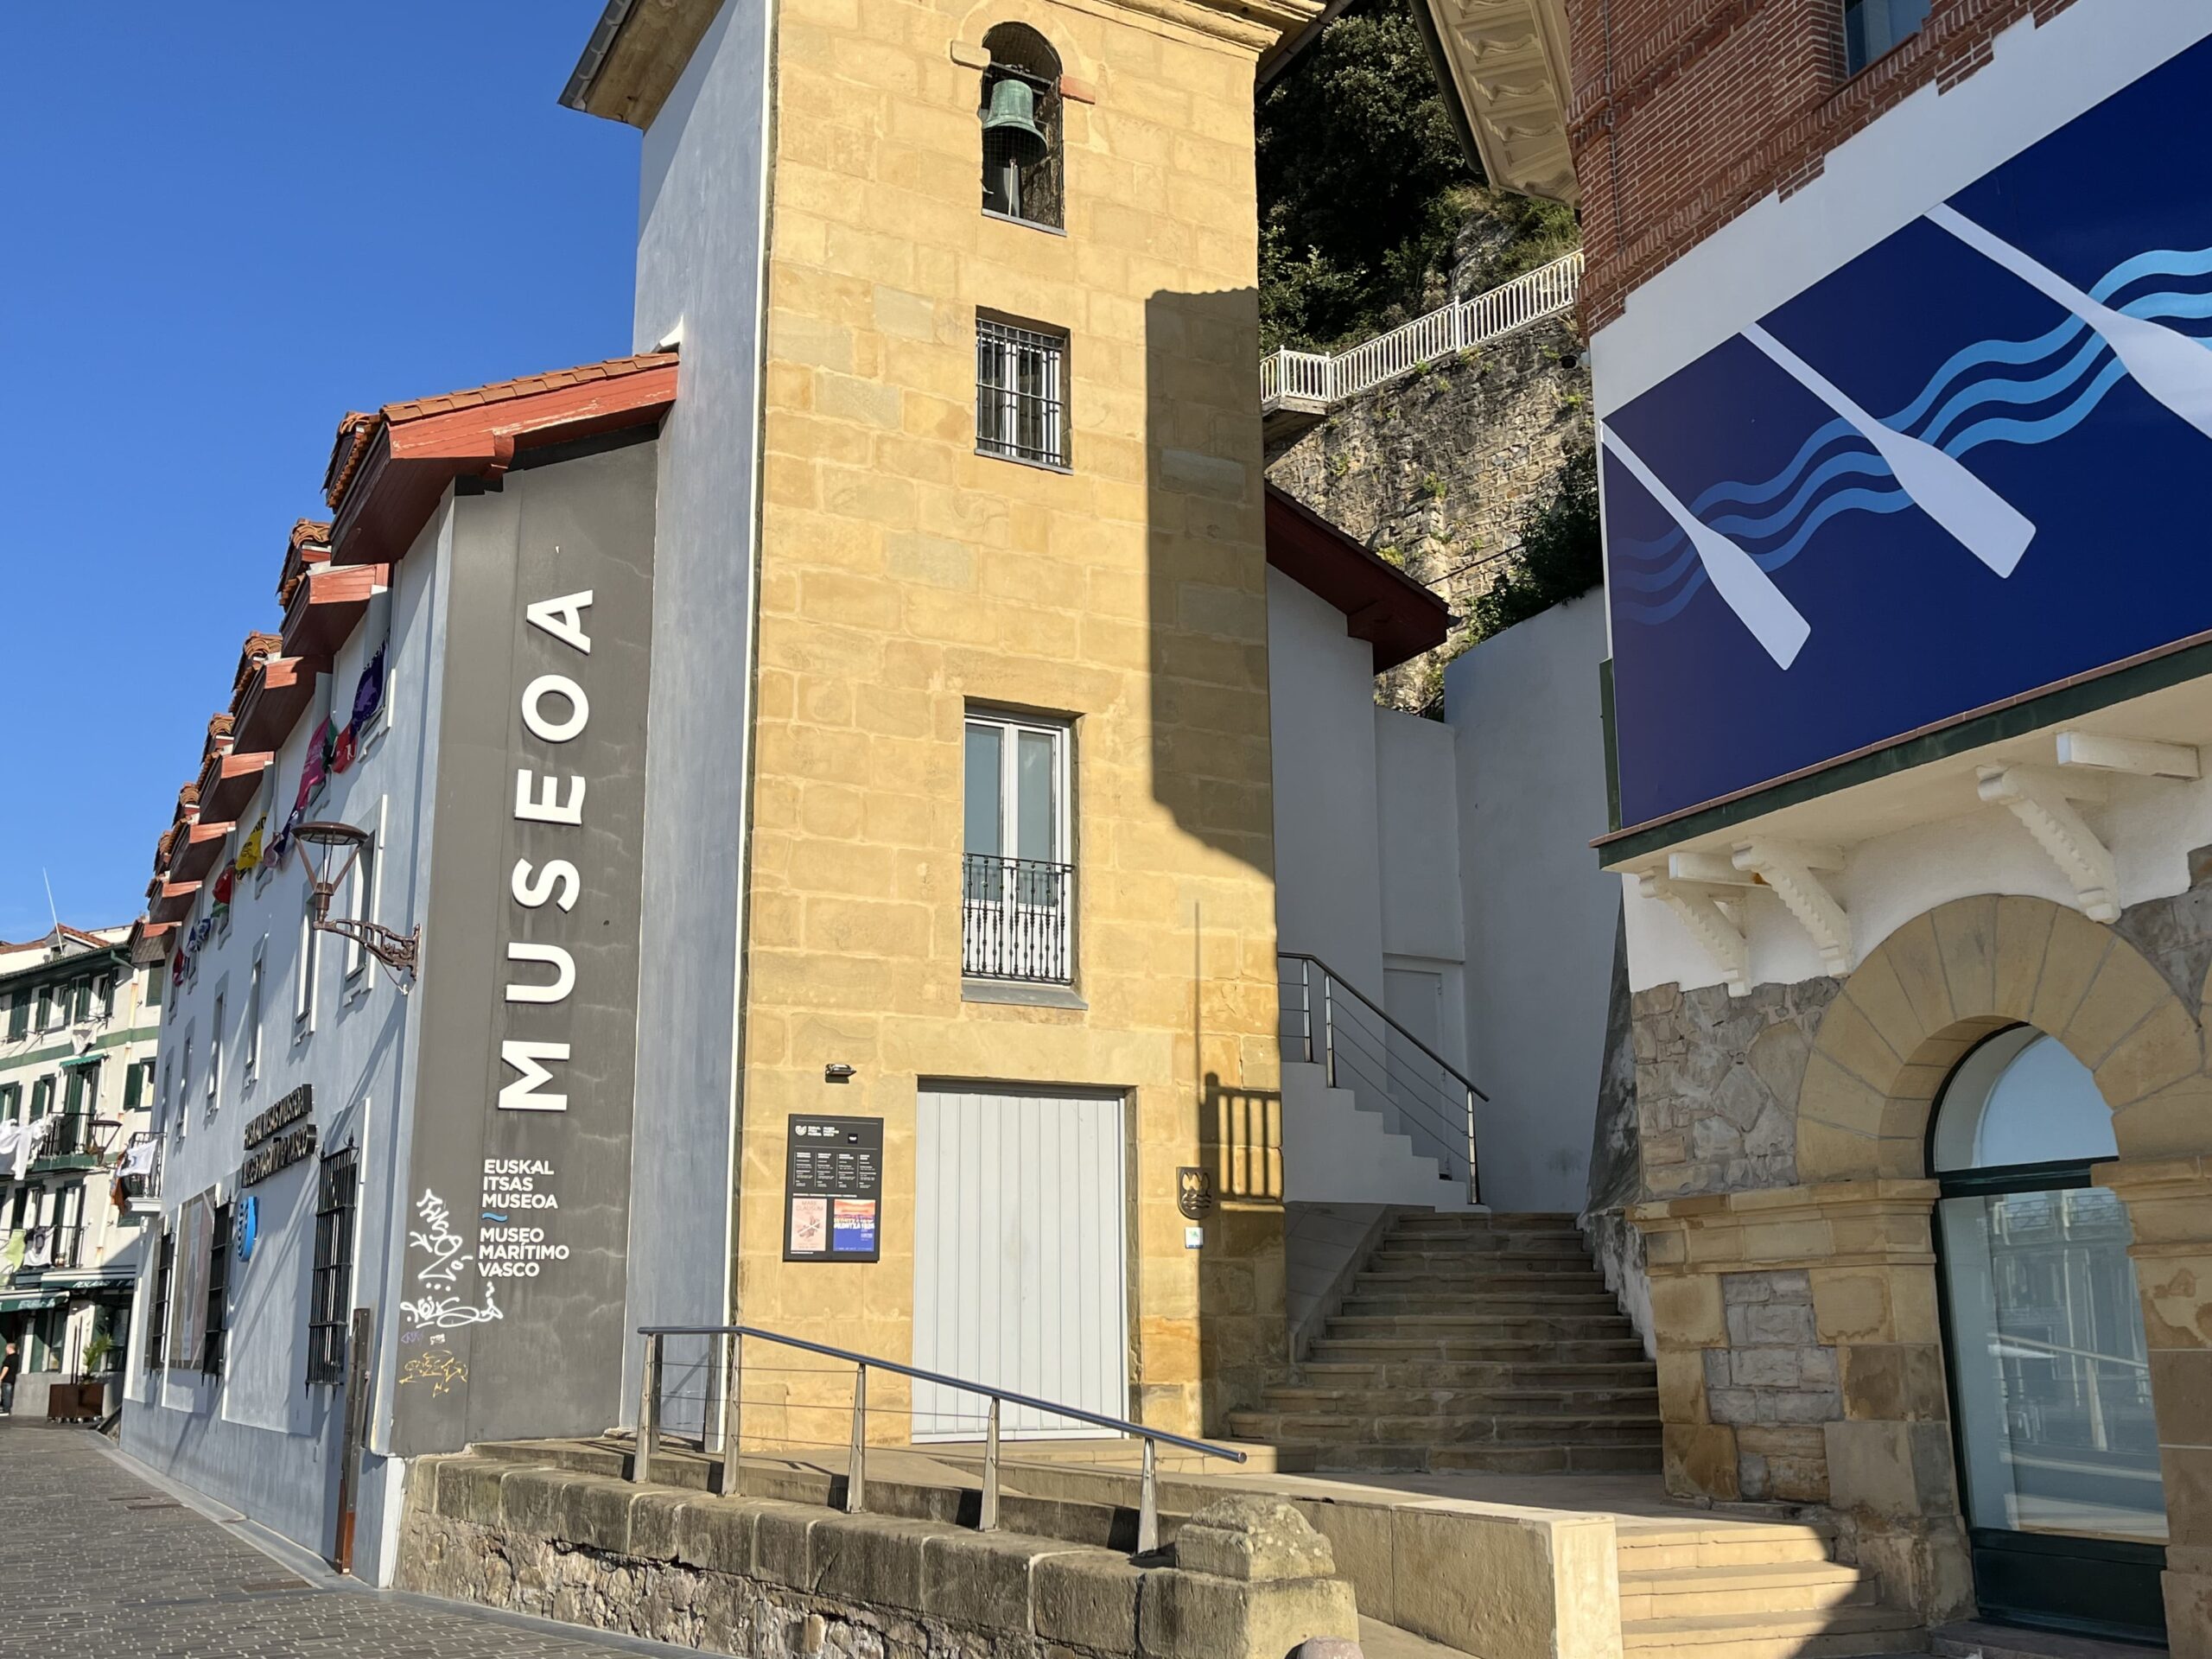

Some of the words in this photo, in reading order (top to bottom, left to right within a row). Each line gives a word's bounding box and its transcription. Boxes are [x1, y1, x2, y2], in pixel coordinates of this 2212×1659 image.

[498, 588, 594, 1111] MUSEOA
[484, 1159, 555, 1175] EUSKAL
[483, 1176, 534, 1192] ITSAS
[482, 1193, 559, 1209] MUSEOA
[480, 1228, 544, 1243] MUSEO
[479, 1242, 570, 1260] MARÍTIMO
[477, 1262, 540, 1277] VASCO
